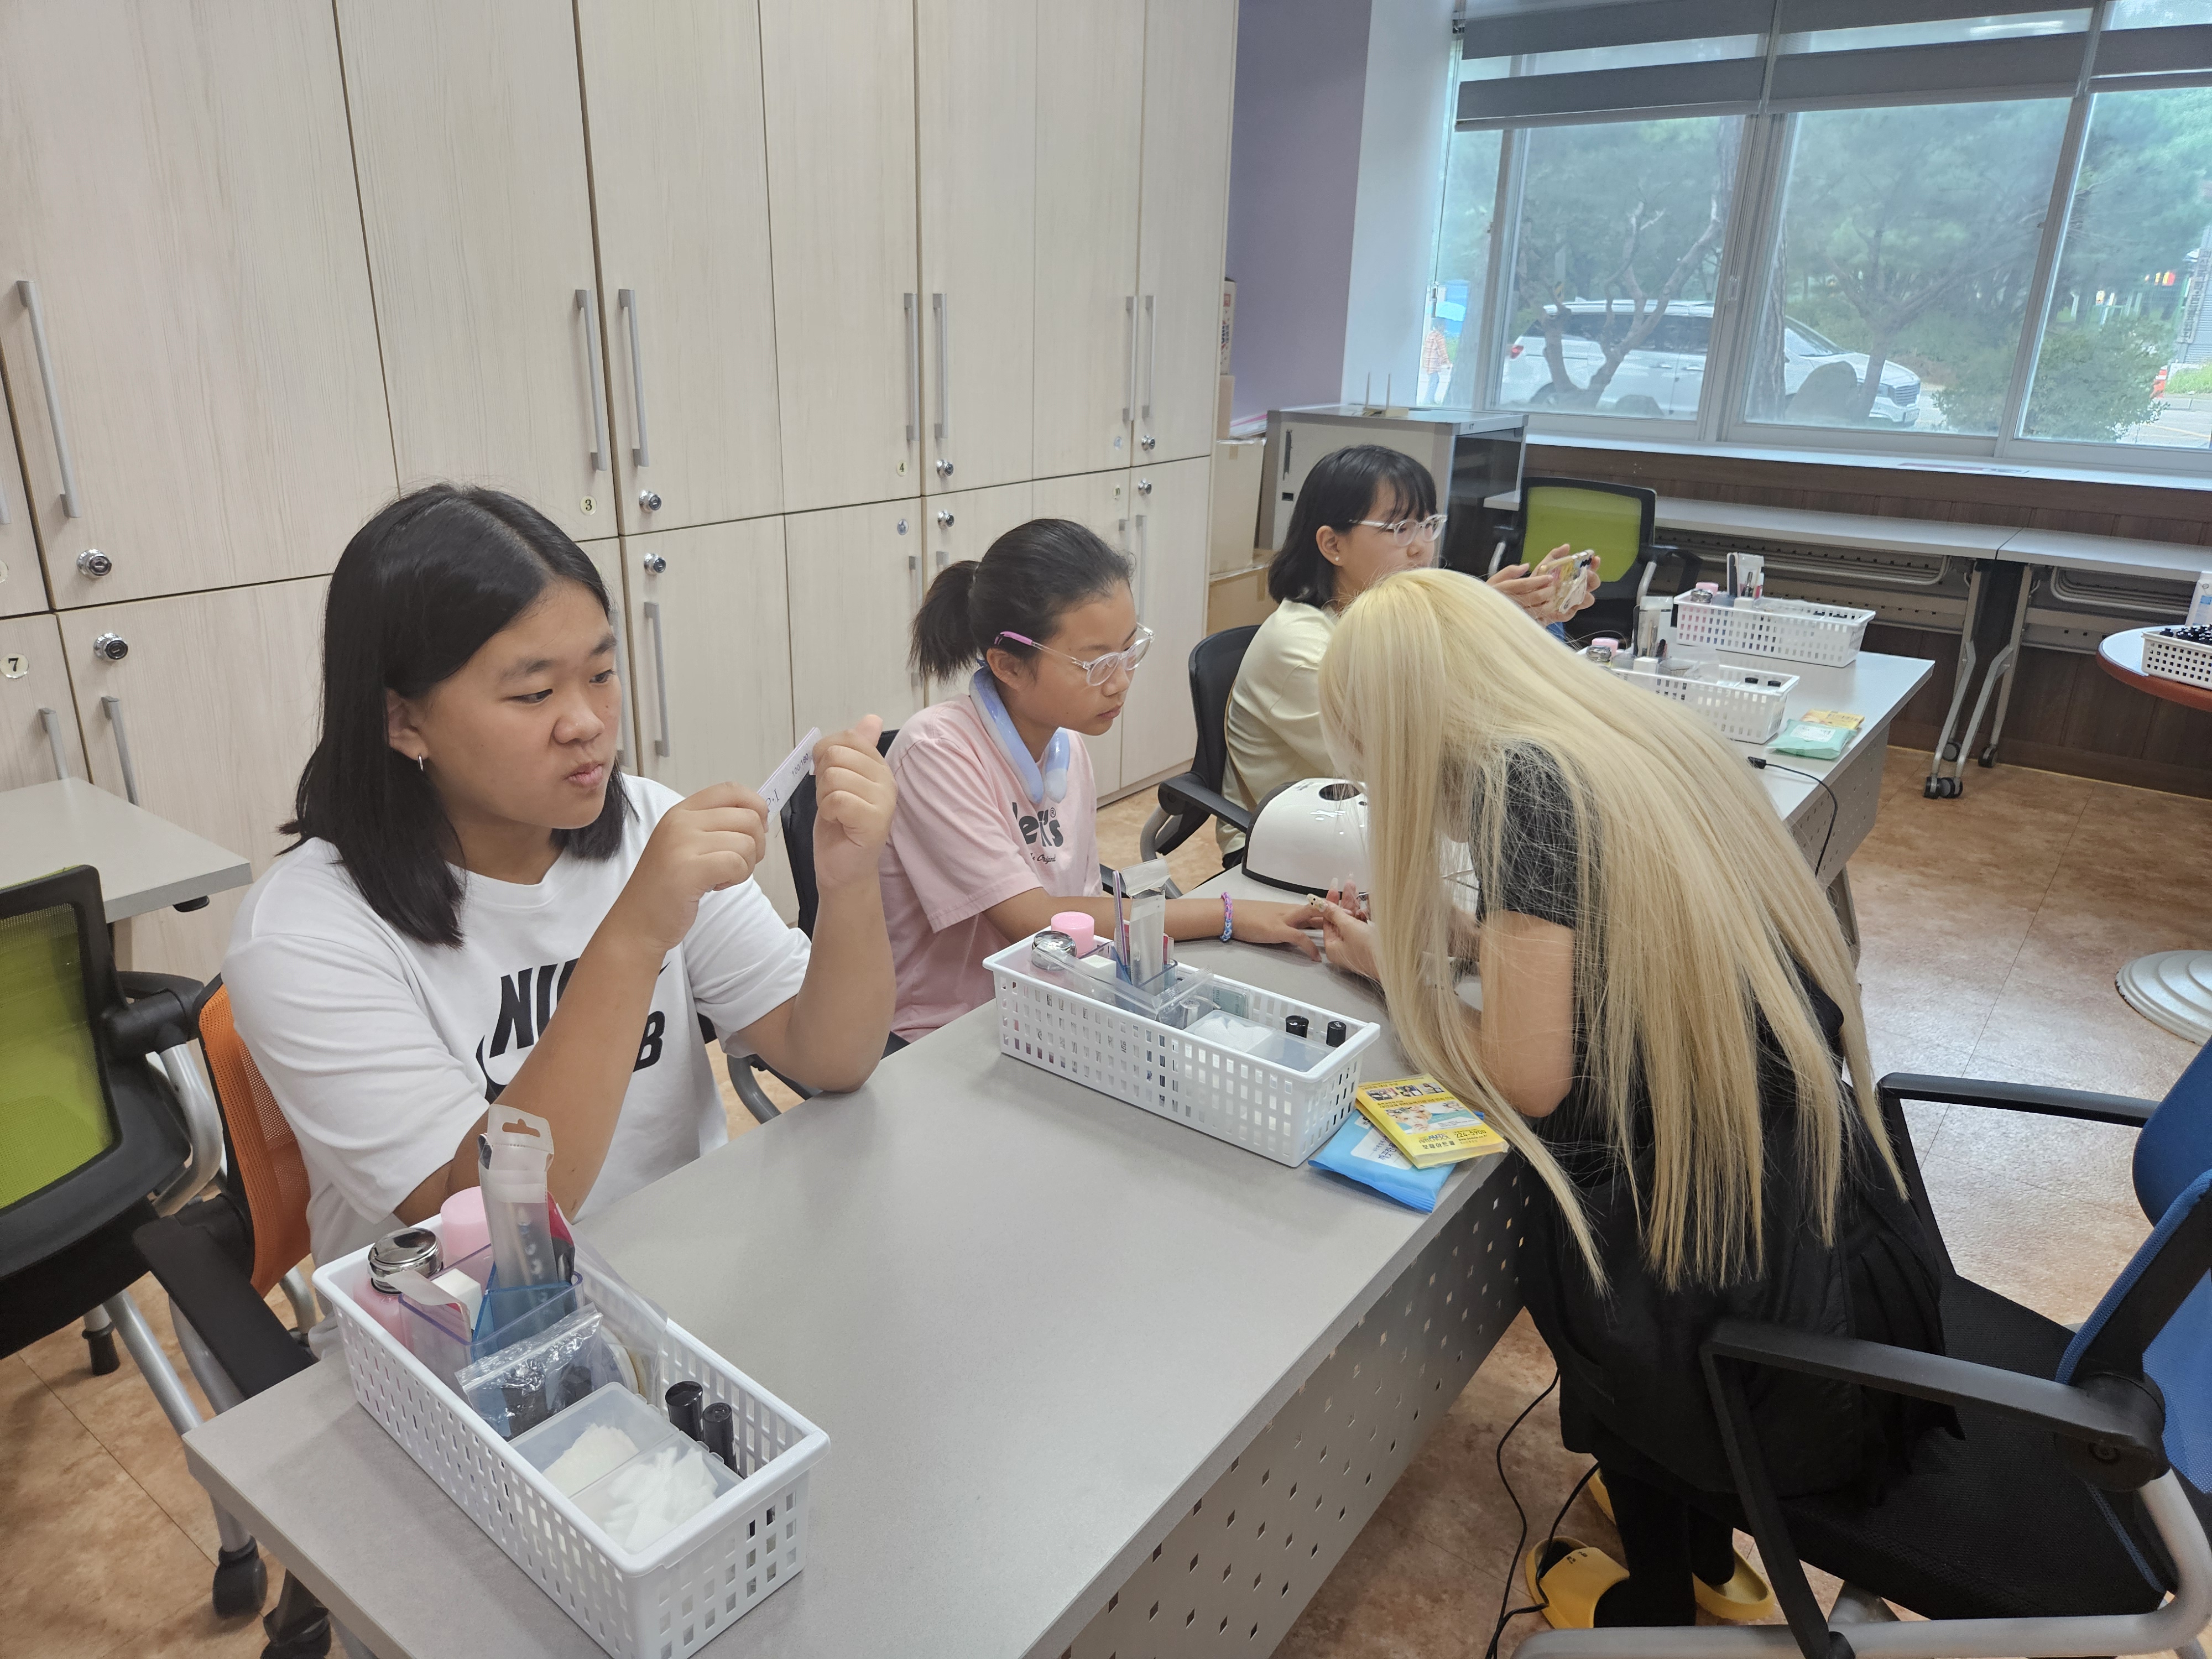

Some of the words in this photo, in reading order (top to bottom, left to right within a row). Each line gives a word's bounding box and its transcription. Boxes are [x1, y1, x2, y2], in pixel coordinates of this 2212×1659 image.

[899, 462, 905, 472] 4
[585, 499, 592, 511] 3
[8, 657, 19, 672] 7
[489, 958, 580, 1058] NI
[1454, 1129, 1486, 1138] 224-5900
